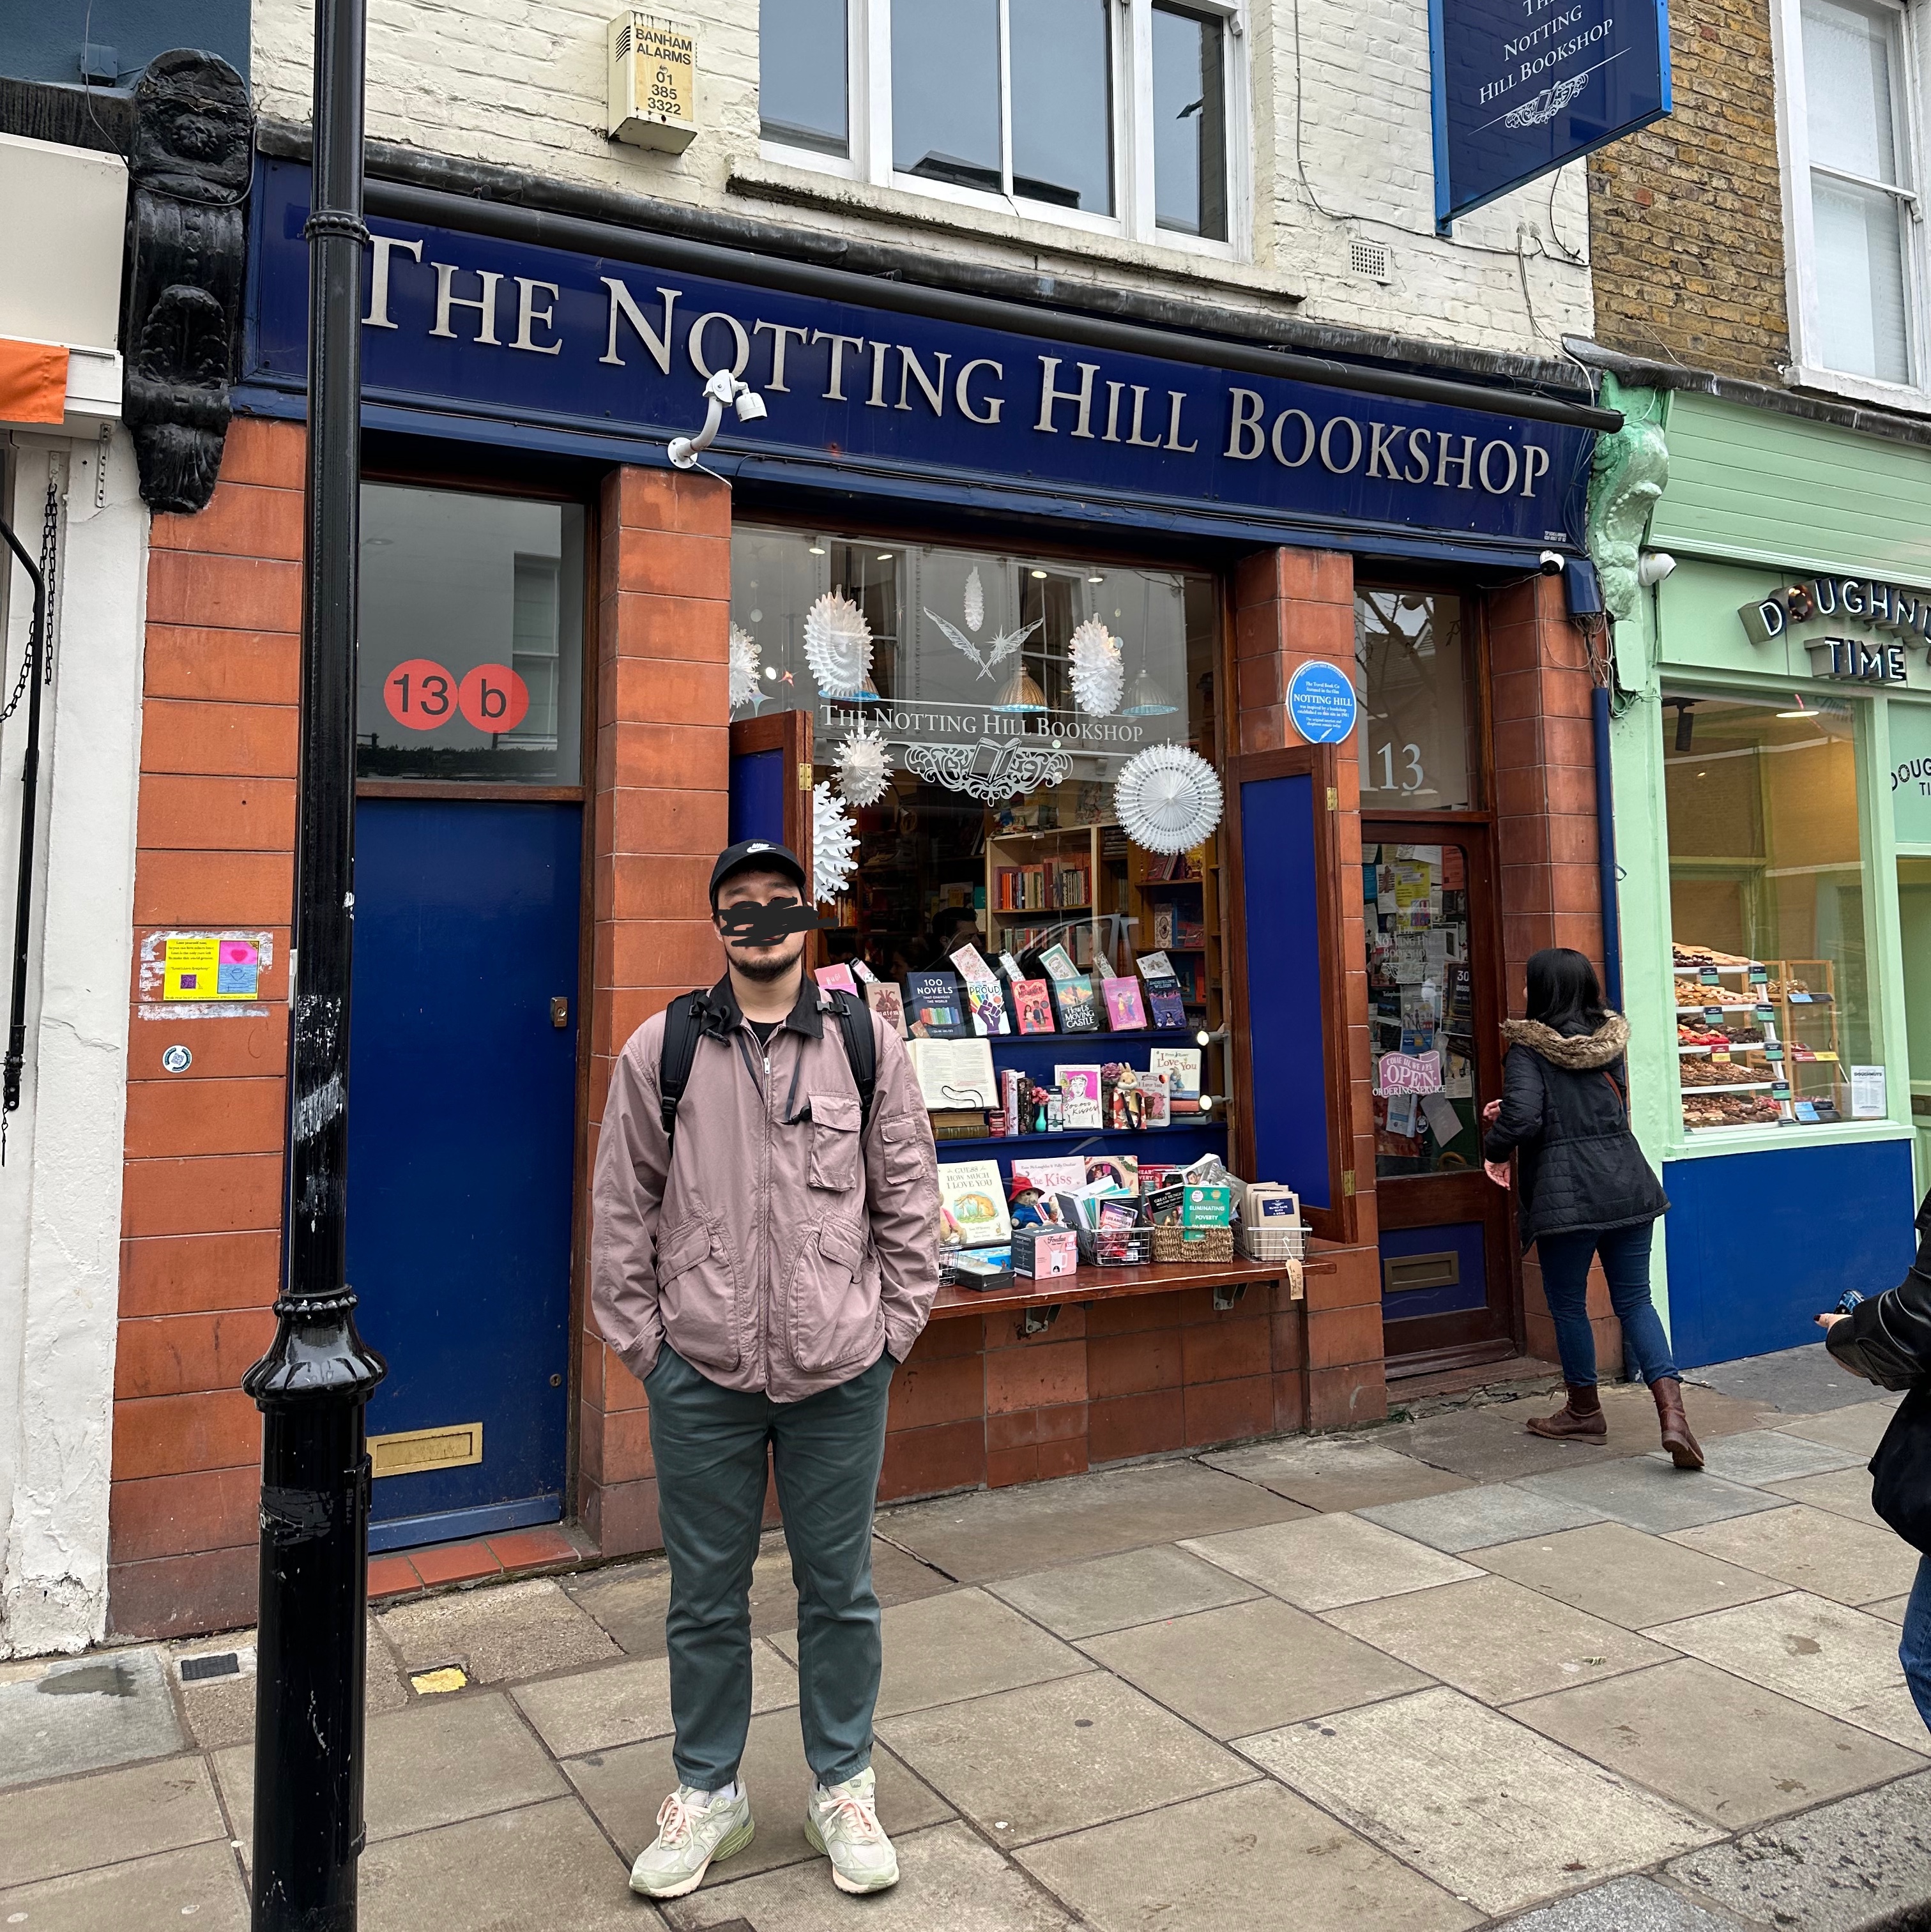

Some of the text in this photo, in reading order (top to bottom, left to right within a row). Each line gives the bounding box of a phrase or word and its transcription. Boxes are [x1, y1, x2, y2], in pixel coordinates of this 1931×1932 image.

[1523, 0, 1563, 17] TH
[636, 29, 692, 52] BANHAM
[1504, 4, 1583, 61] NOTTING
[636, 43, 691, 65] ALARMS
[1479, 19, 1614, 105] HILL BOOKSHOP
[651, 84, 677, 100] 385
[647, 97, 682, 116] 3322
[361, 234, 1550, 498] THE NOTTING HILL BOOKSHOP
[1824, 636, 1907, 681] TIME
[393, 674, 507, 718] 13 b
[1294, 693, 1353, 706] NOTTING HILL
[820, 704, 1143, 742] THE NOTTING HILL BOOKSHOP
[1377, 742, 1424, 791] 13
[917, 986, 953, 994] NOVELS
[969, 985, 1000, 996] PROUD
[1065, 1010, 1095, 1021] MOVING
[1066, 1017, 1095, 1028] CASTLE
[1161, 1053, 1164, 1061] I
[1386, 1065, 1435, 1090] OPEN
[952, 1180, 975, 1189] LOVE
[975, 1179, 993, 1187] YOU
[1044, 1173, 1072, 1187] Kiss
